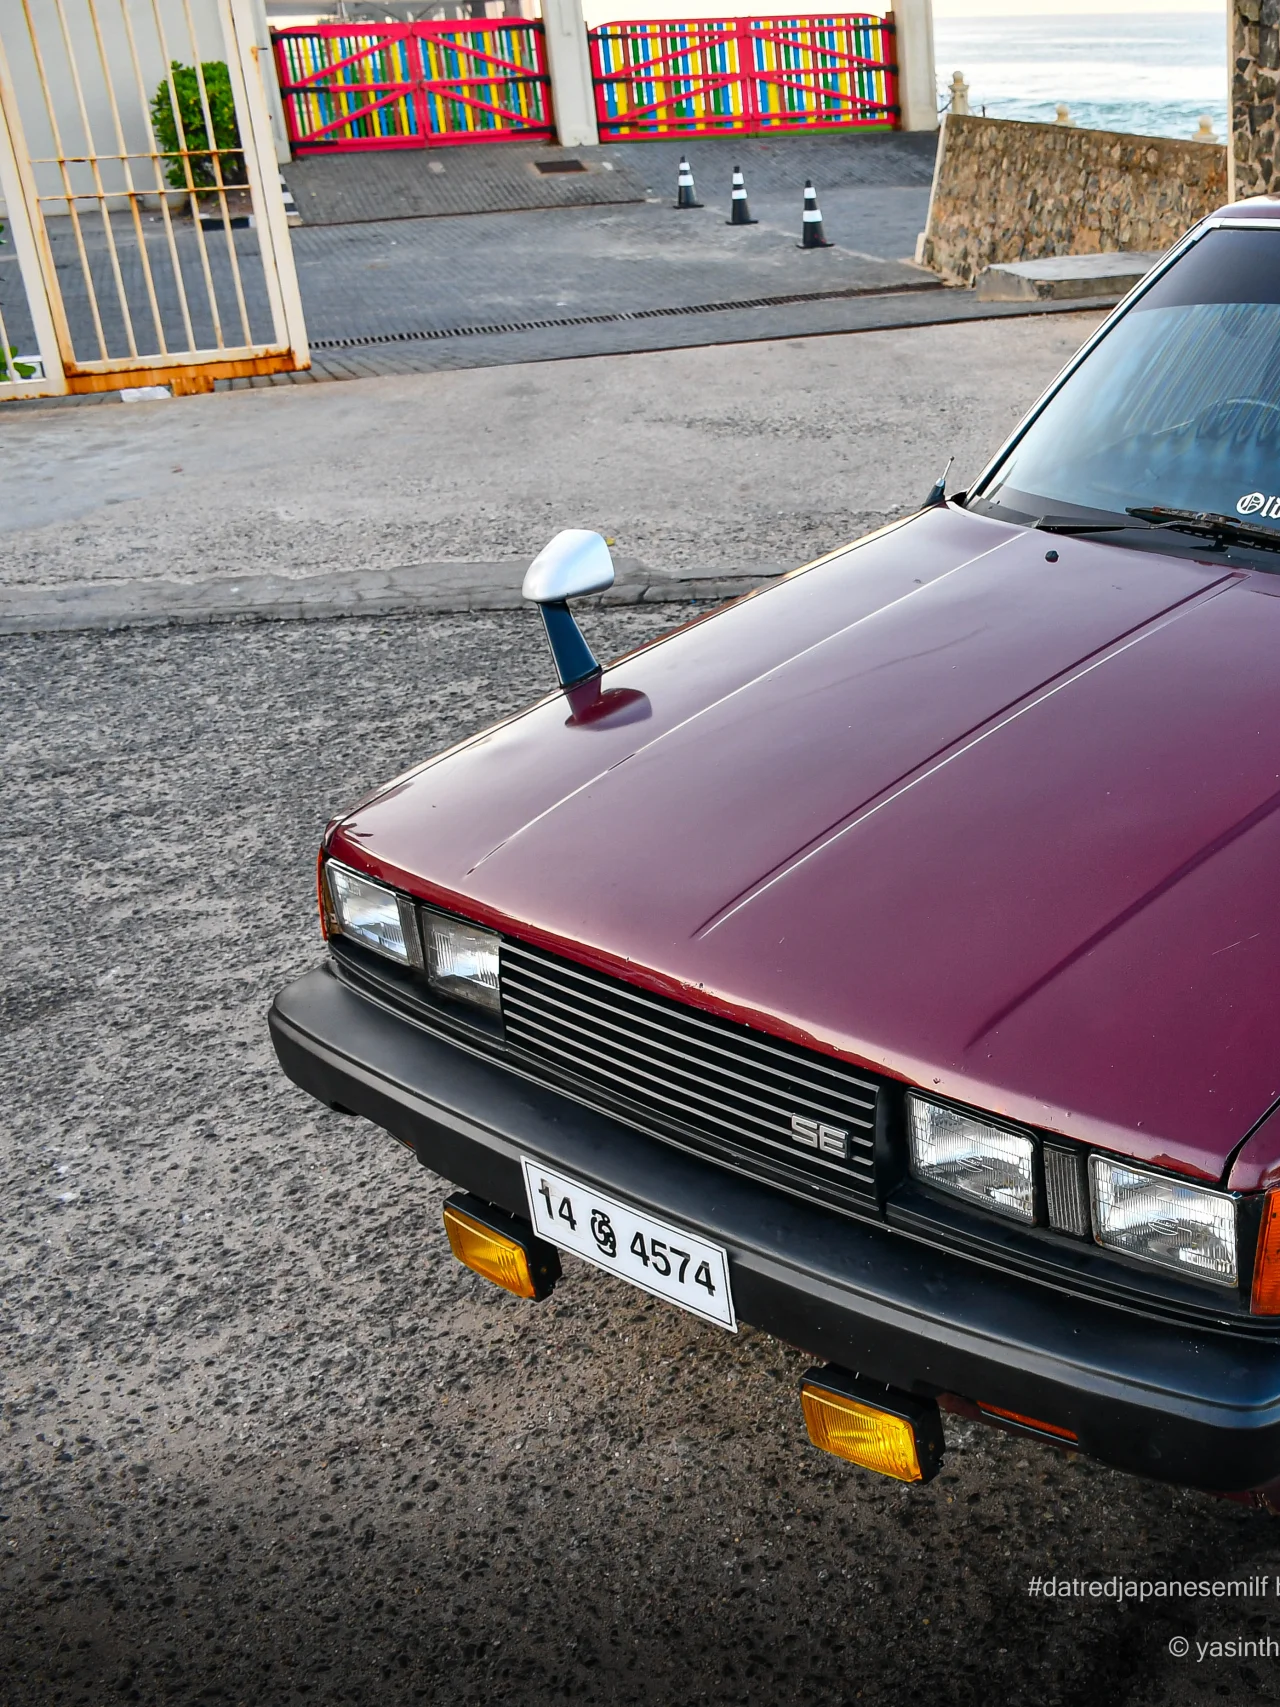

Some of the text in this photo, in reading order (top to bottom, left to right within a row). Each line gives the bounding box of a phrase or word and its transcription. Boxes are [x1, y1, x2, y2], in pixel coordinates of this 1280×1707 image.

[791, 1113, 849, 1159] SE
[538, 1178, 577, 1231] 14
[630, 1231, 716, 1297] 4574
